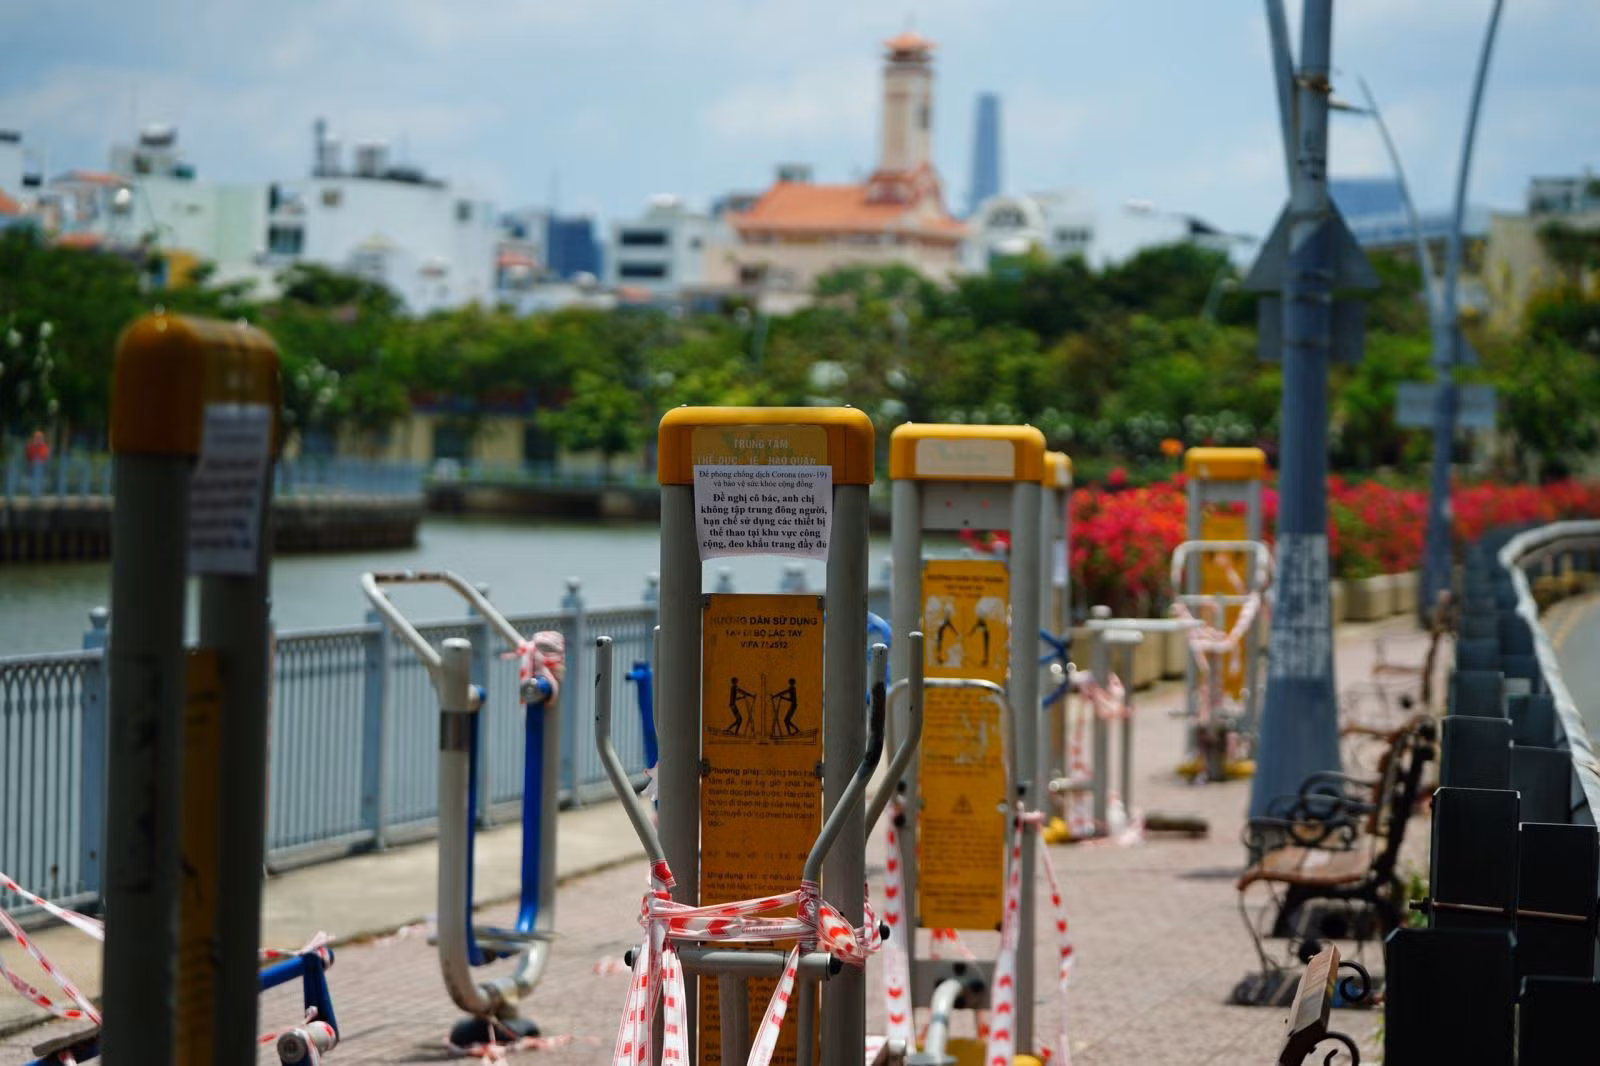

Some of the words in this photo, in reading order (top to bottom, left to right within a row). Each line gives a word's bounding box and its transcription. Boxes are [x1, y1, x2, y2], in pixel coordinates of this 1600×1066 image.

[755, 470, 770, 479] dịch
[771, 470, 796, 478] Corona
[797, 470, 828, 479] (nov-19)
[727, 493, 748, 504] nghị
[749, 493, 759, 502] cô
[762, 493, 780, 503] bác,
[782, 494, 799, 503] anh
[801, 494, 815, 504] chị
[701, 505, 729, 515] không
[748, 506, 773, 515] trung
[799, 505, 828, 516] người,
[703, 517, 720, 527] hạn
[753, 517, 776, 527] dụng
[777, 517, 792, 525] các
[725, 528, 746, 537] thao
[748, 528, 760, 538] tại
[762, 528, 779, 537] khu
[728, 540, 744, 548] đeo
[746, 537, 769, 548] khẩu
[771, 540, 796, 549] trang
[788, 629, 803, 638] TAY
